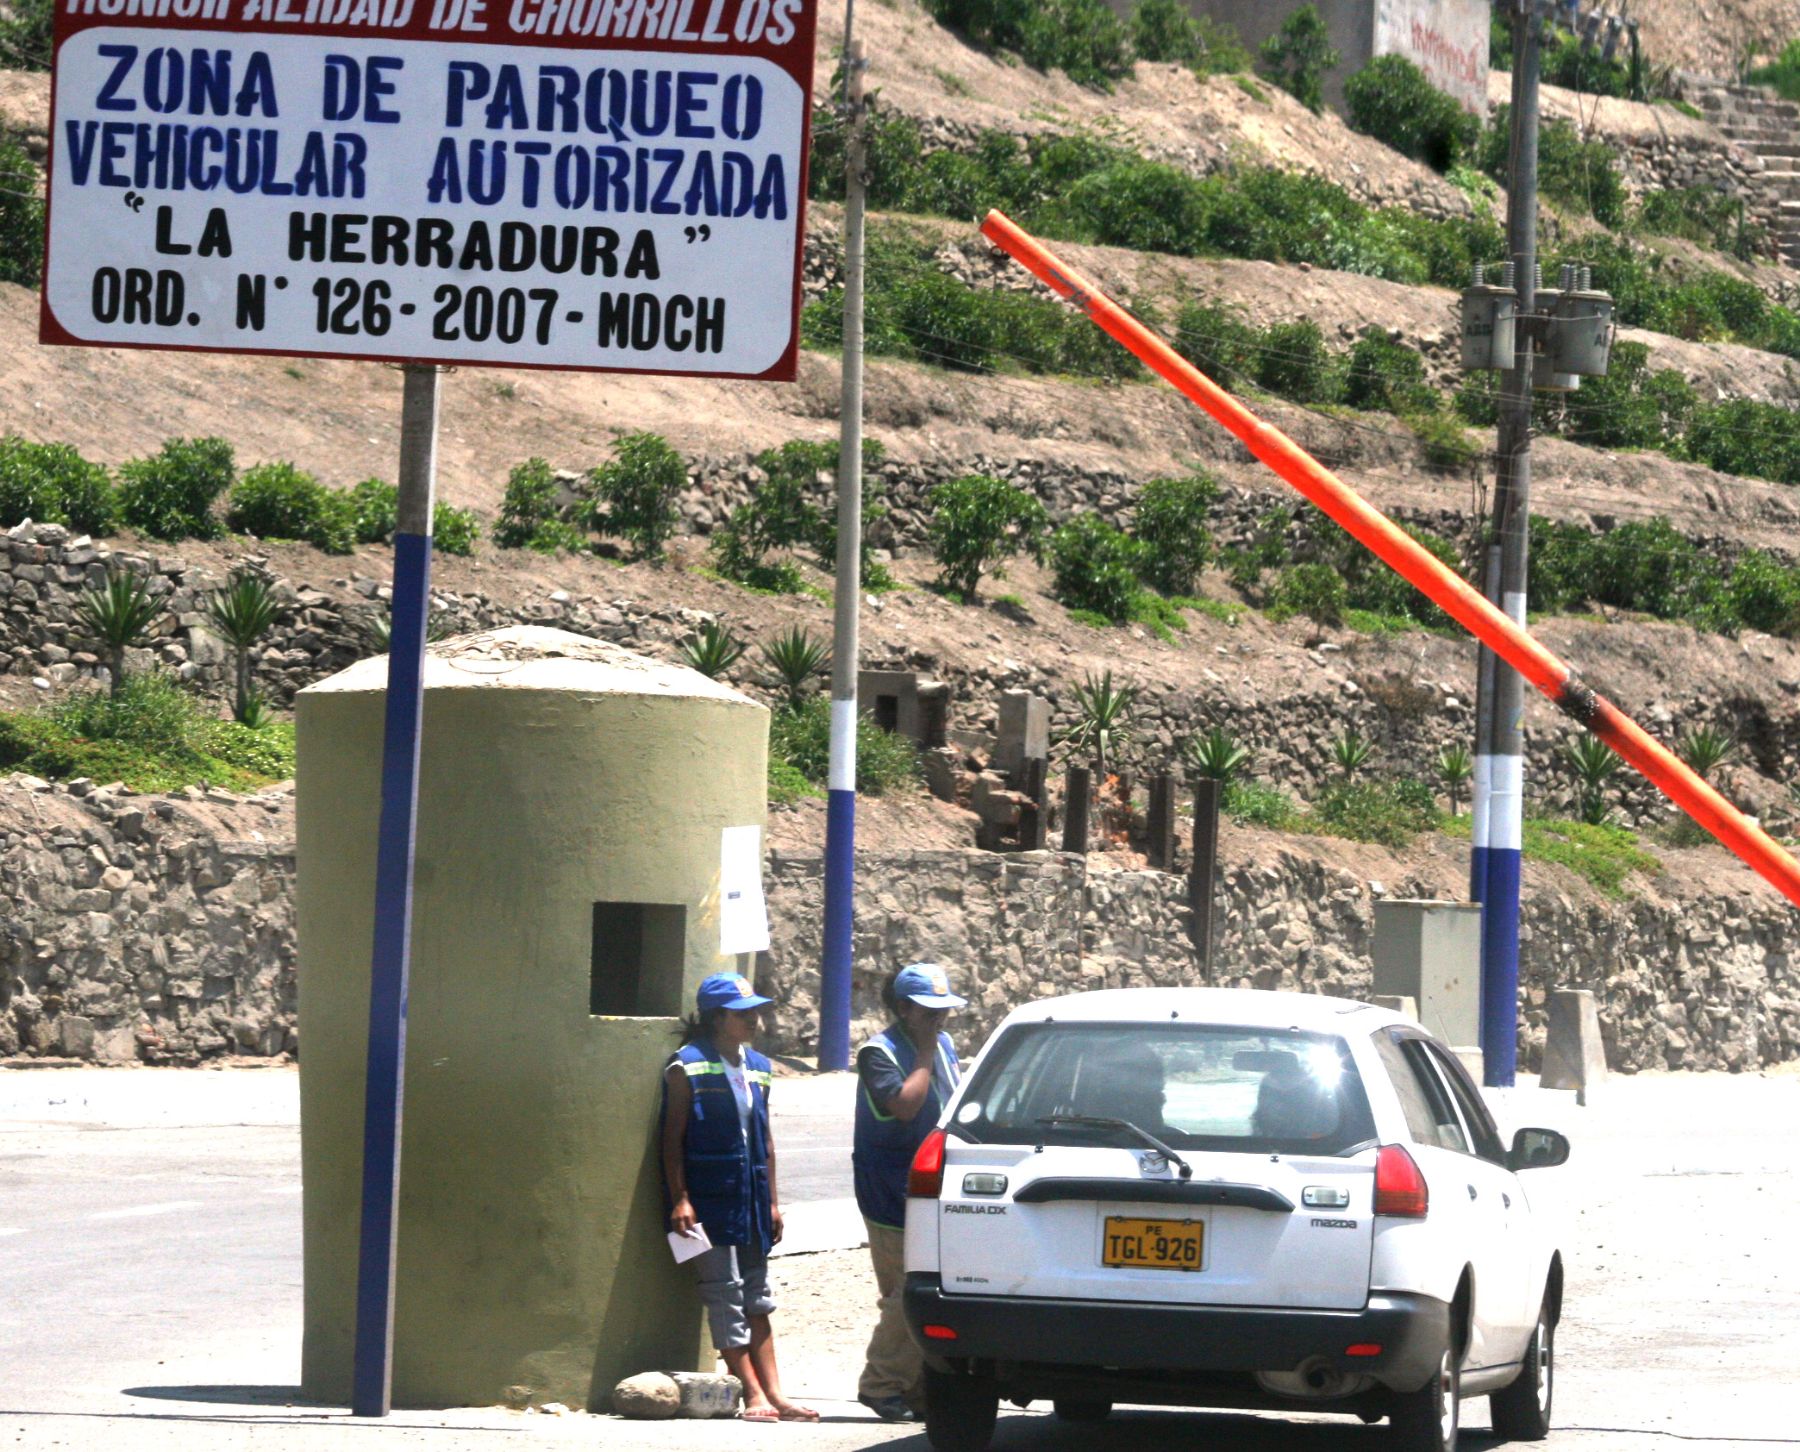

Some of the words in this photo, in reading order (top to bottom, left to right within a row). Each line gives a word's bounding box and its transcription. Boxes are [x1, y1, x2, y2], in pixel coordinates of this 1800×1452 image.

[428, 0, 488, 32] DE
[508, 0, 803, 45] CHORRILLOS
[96, 44, 279, 118] ZONA
[323, 54, 404, 124] DE
[445, 60, 764, 143] PARQUEO
[65, 119, 368, 199] VEHICULAR
[427, 136, 789, 221] AUTORIZADA
[91, 266, 201, 327] ORD.
[1145, 1225, 1163, 1236] PE
